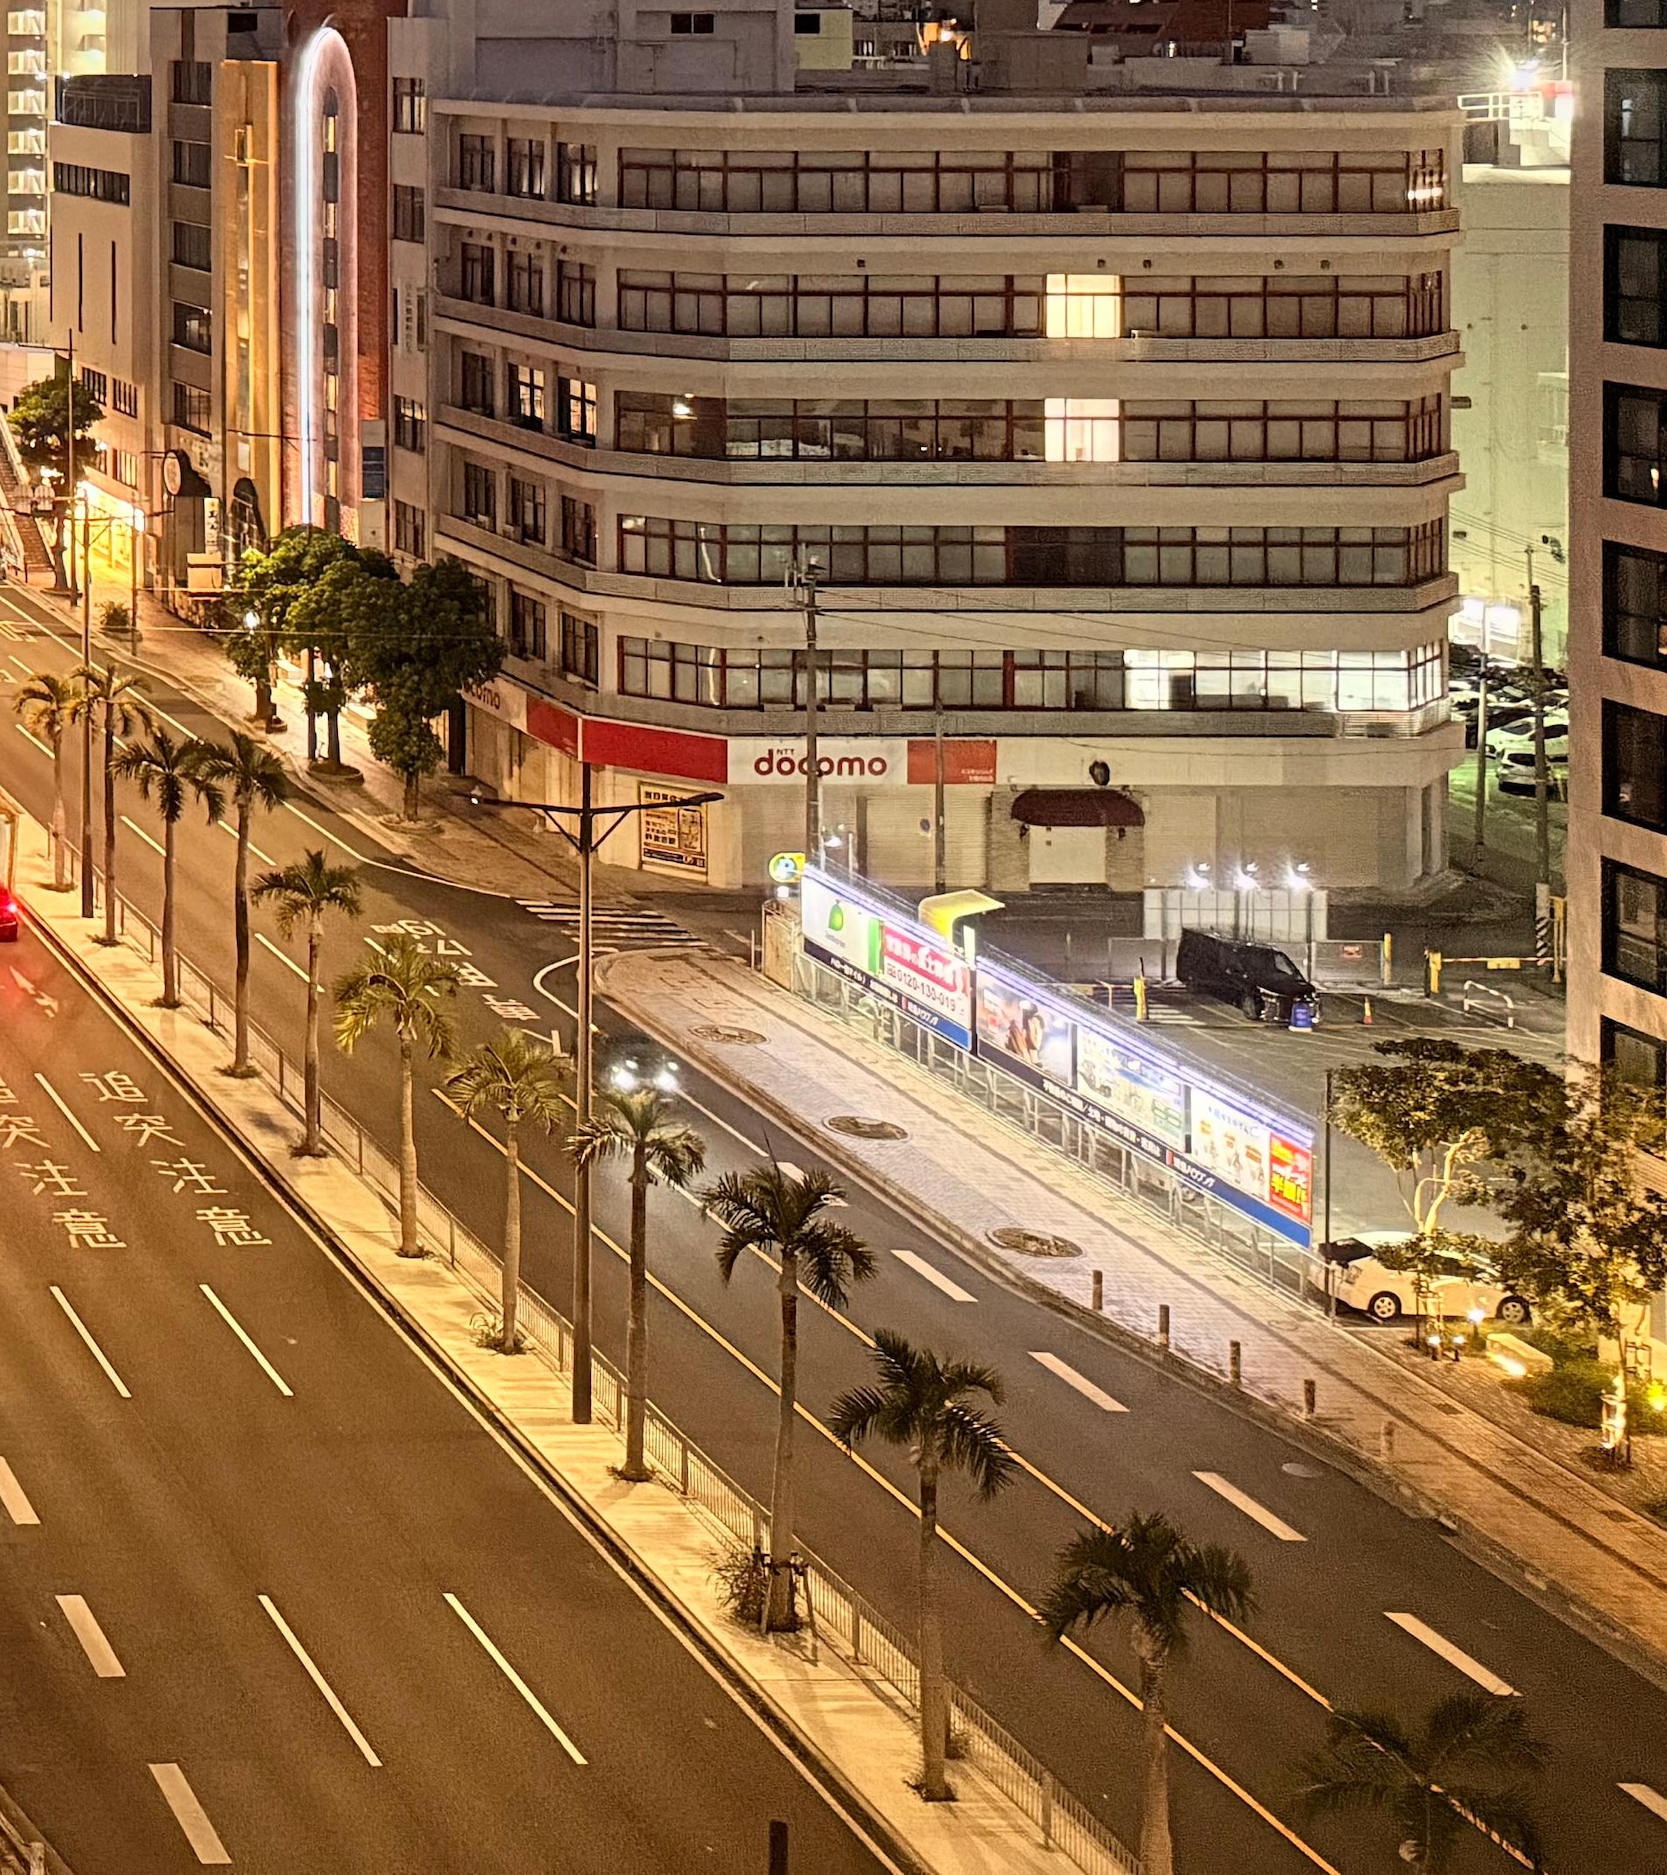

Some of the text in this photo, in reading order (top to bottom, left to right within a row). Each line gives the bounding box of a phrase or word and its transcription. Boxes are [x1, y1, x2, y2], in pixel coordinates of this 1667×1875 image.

[754, 748, 888, 777] docomo
[78, 1070, 273, 1246] 追突注意
